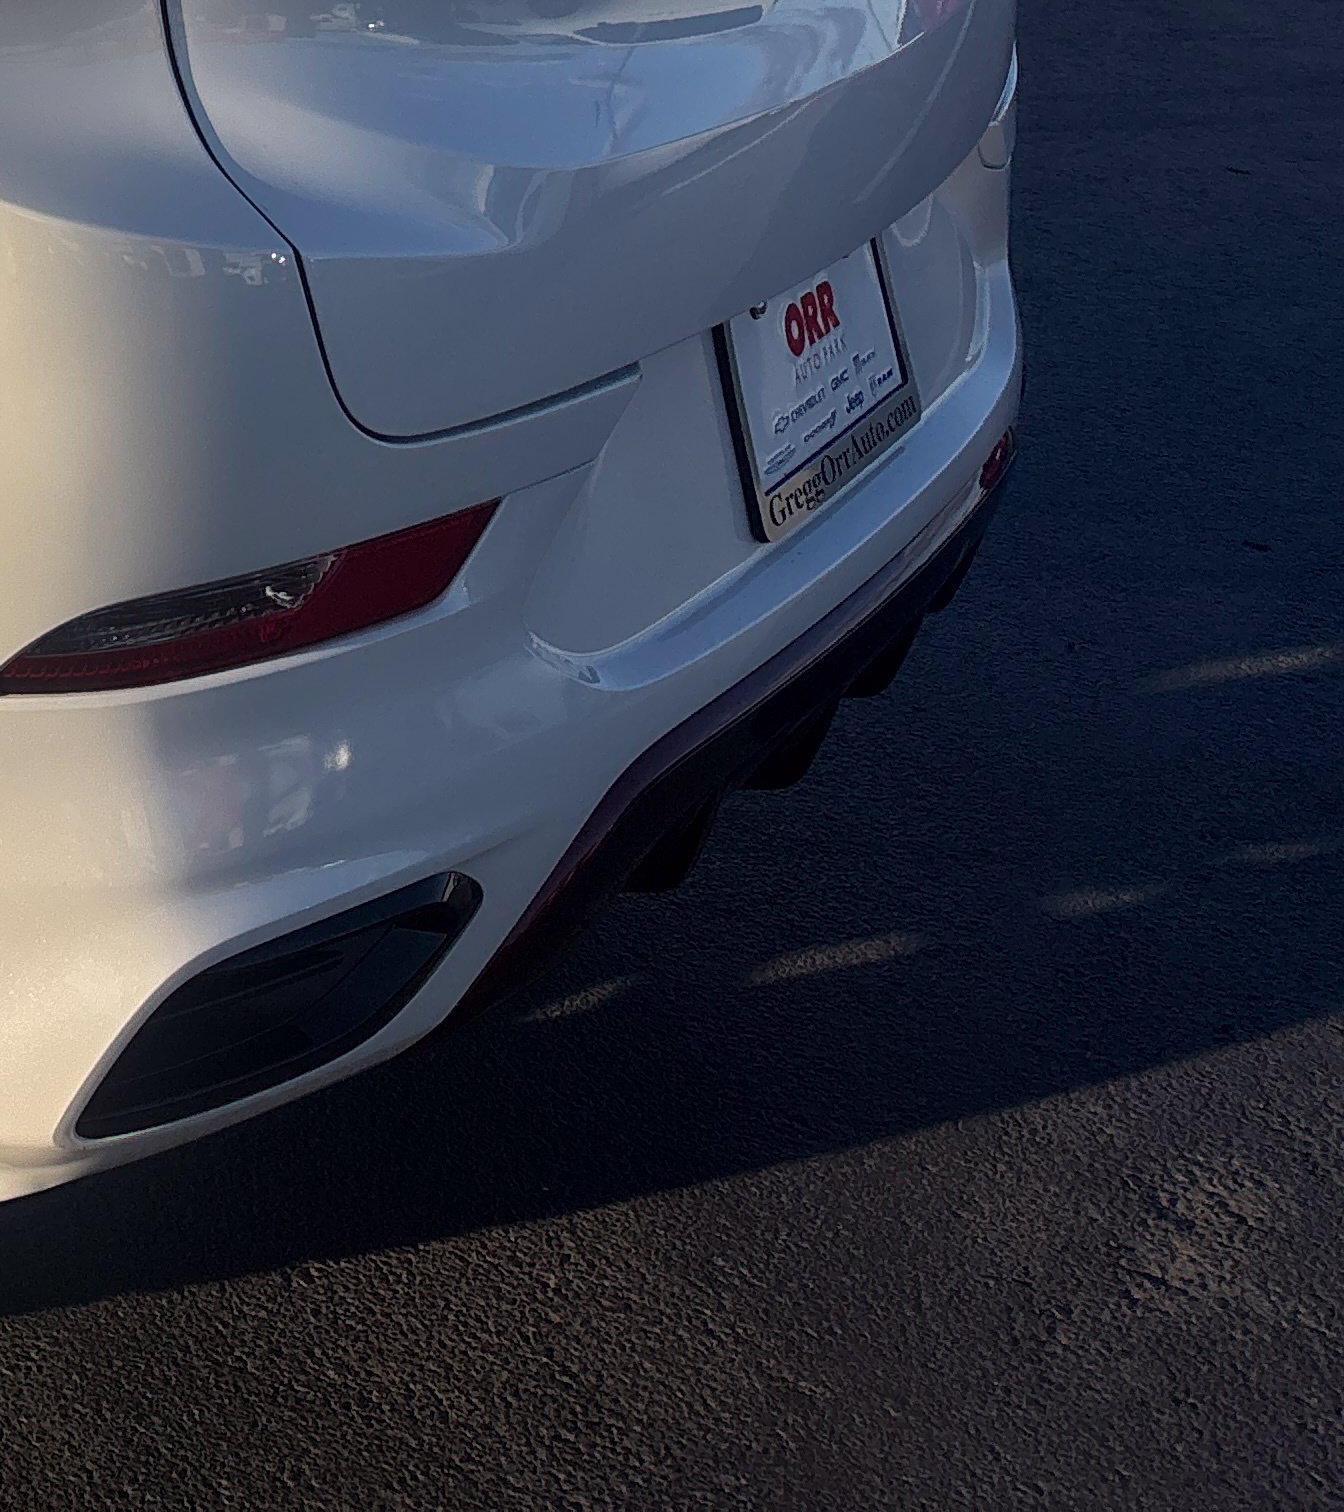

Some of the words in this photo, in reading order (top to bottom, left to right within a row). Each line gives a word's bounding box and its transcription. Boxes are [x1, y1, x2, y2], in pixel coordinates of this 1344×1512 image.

[783, 280, 841, 357] ORR
[794, 352, 821, 385] AUTO
[768, 395, 918, 527] GreggOrrAuto.com
